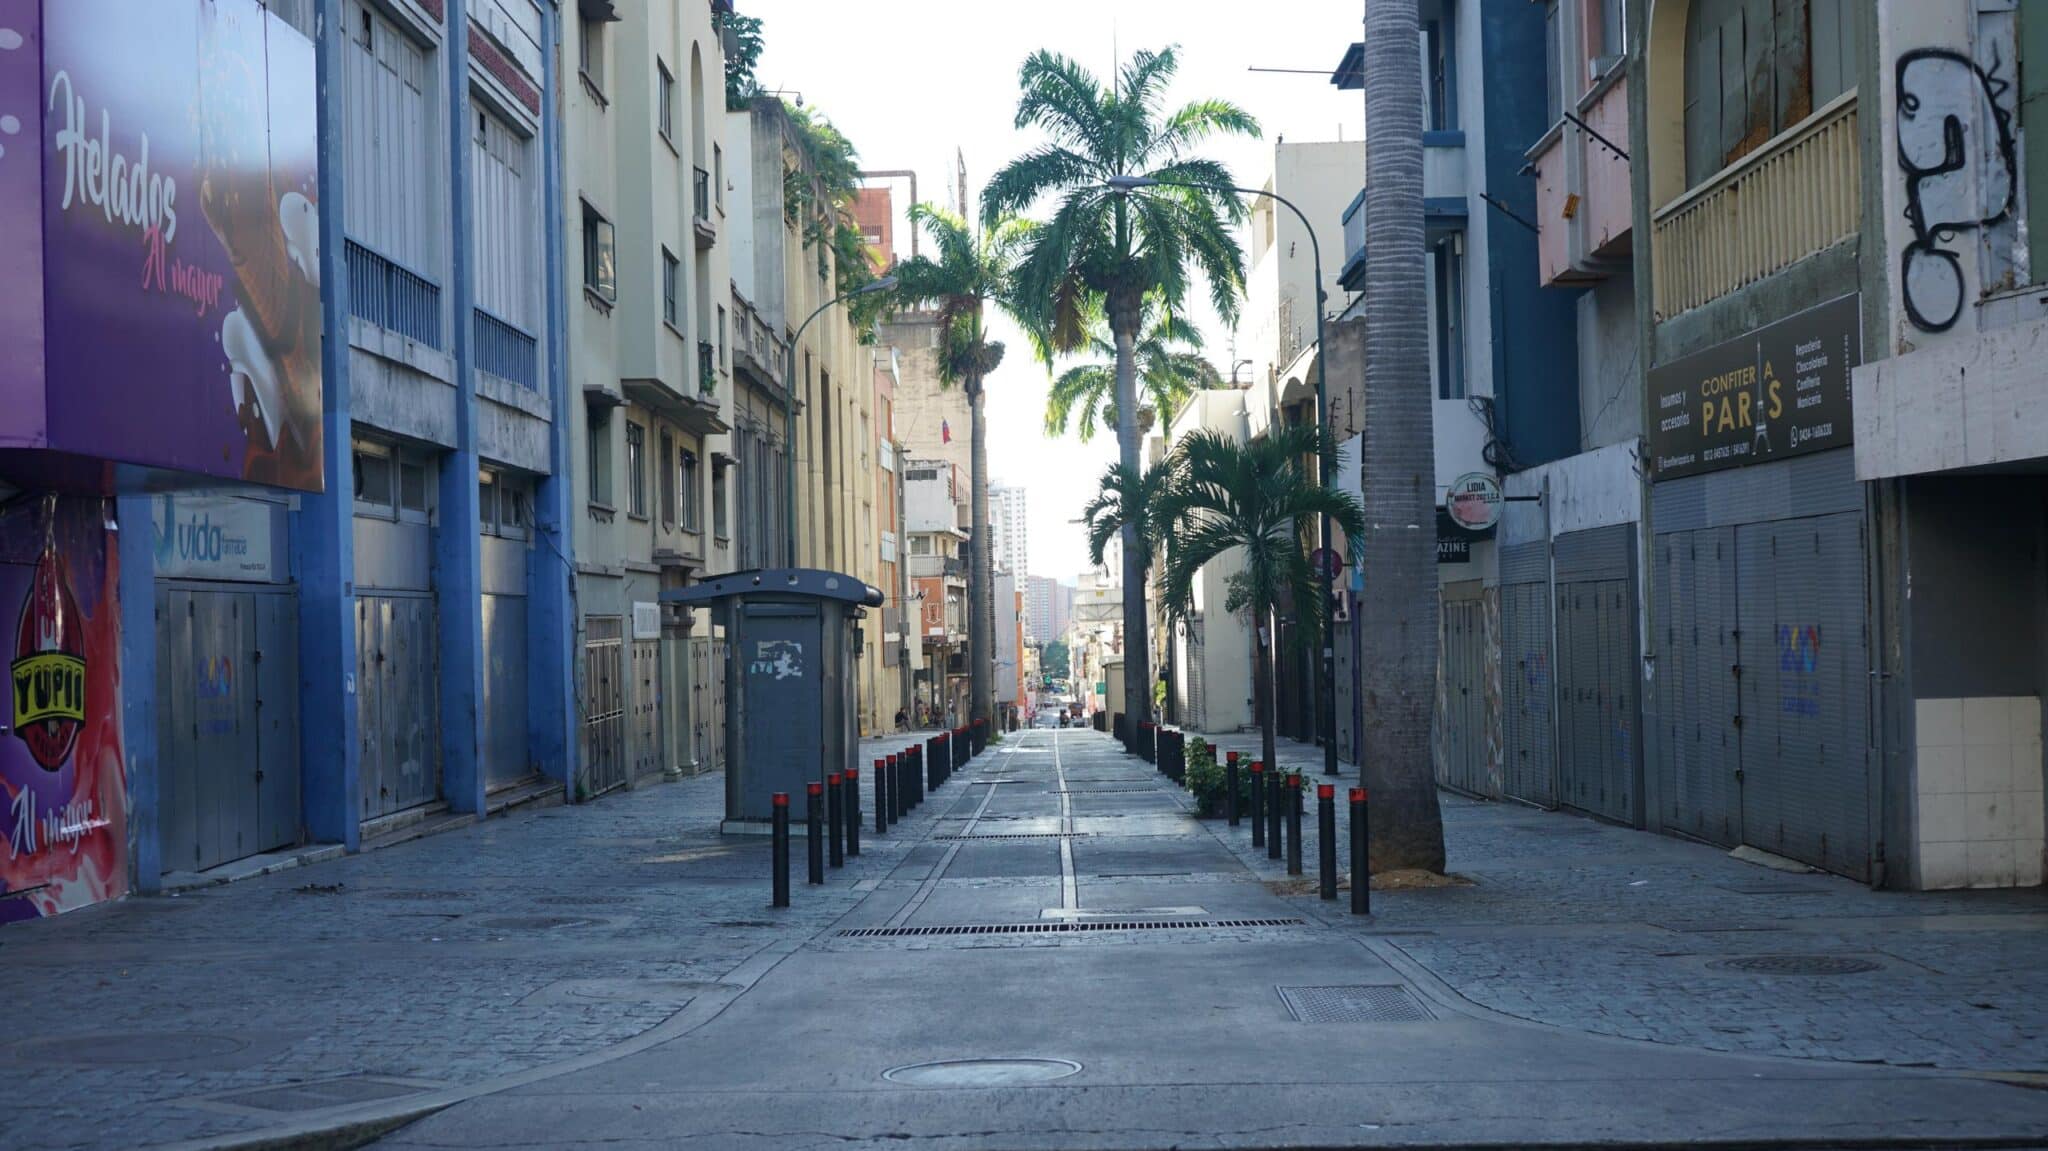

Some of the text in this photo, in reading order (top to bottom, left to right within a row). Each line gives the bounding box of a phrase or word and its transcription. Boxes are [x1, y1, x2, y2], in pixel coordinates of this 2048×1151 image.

[50, 70, 176, 243] Helados
[143, 223, 222, 317] Al mayor
[1466, 482, 1486, 493] LIDIA
[10, 784, 37, 861] Al
